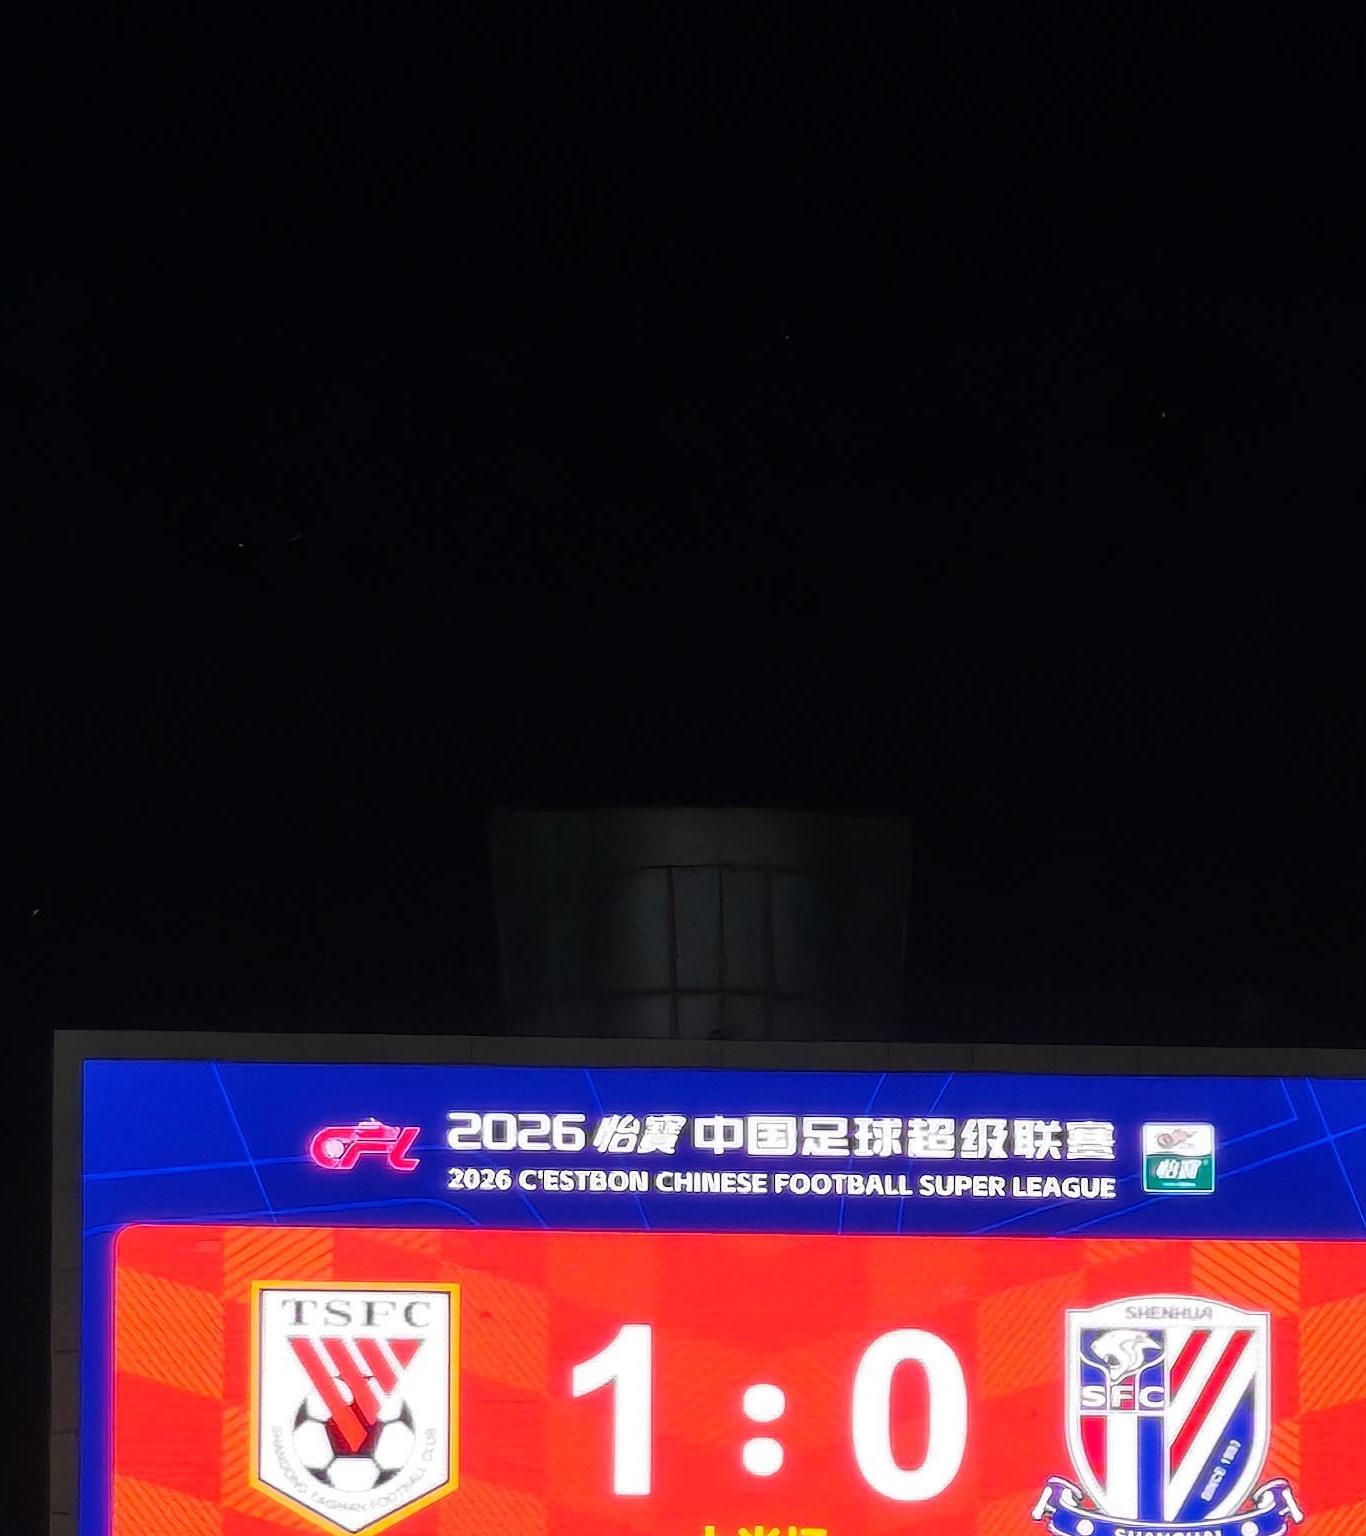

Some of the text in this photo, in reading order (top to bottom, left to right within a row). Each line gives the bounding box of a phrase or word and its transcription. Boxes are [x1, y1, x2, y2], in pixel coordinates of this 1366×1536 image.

[447, 1166, 1116, 1199] 2026 C'ESTBON CHINESE FOOTBALL SUPER LEAGUE
[282, 1299, 432, 1327] TSFC
[1125, 1305, 1213, 1320] SHENHUA
[1081, 1386, 1166, 1408] SFC
